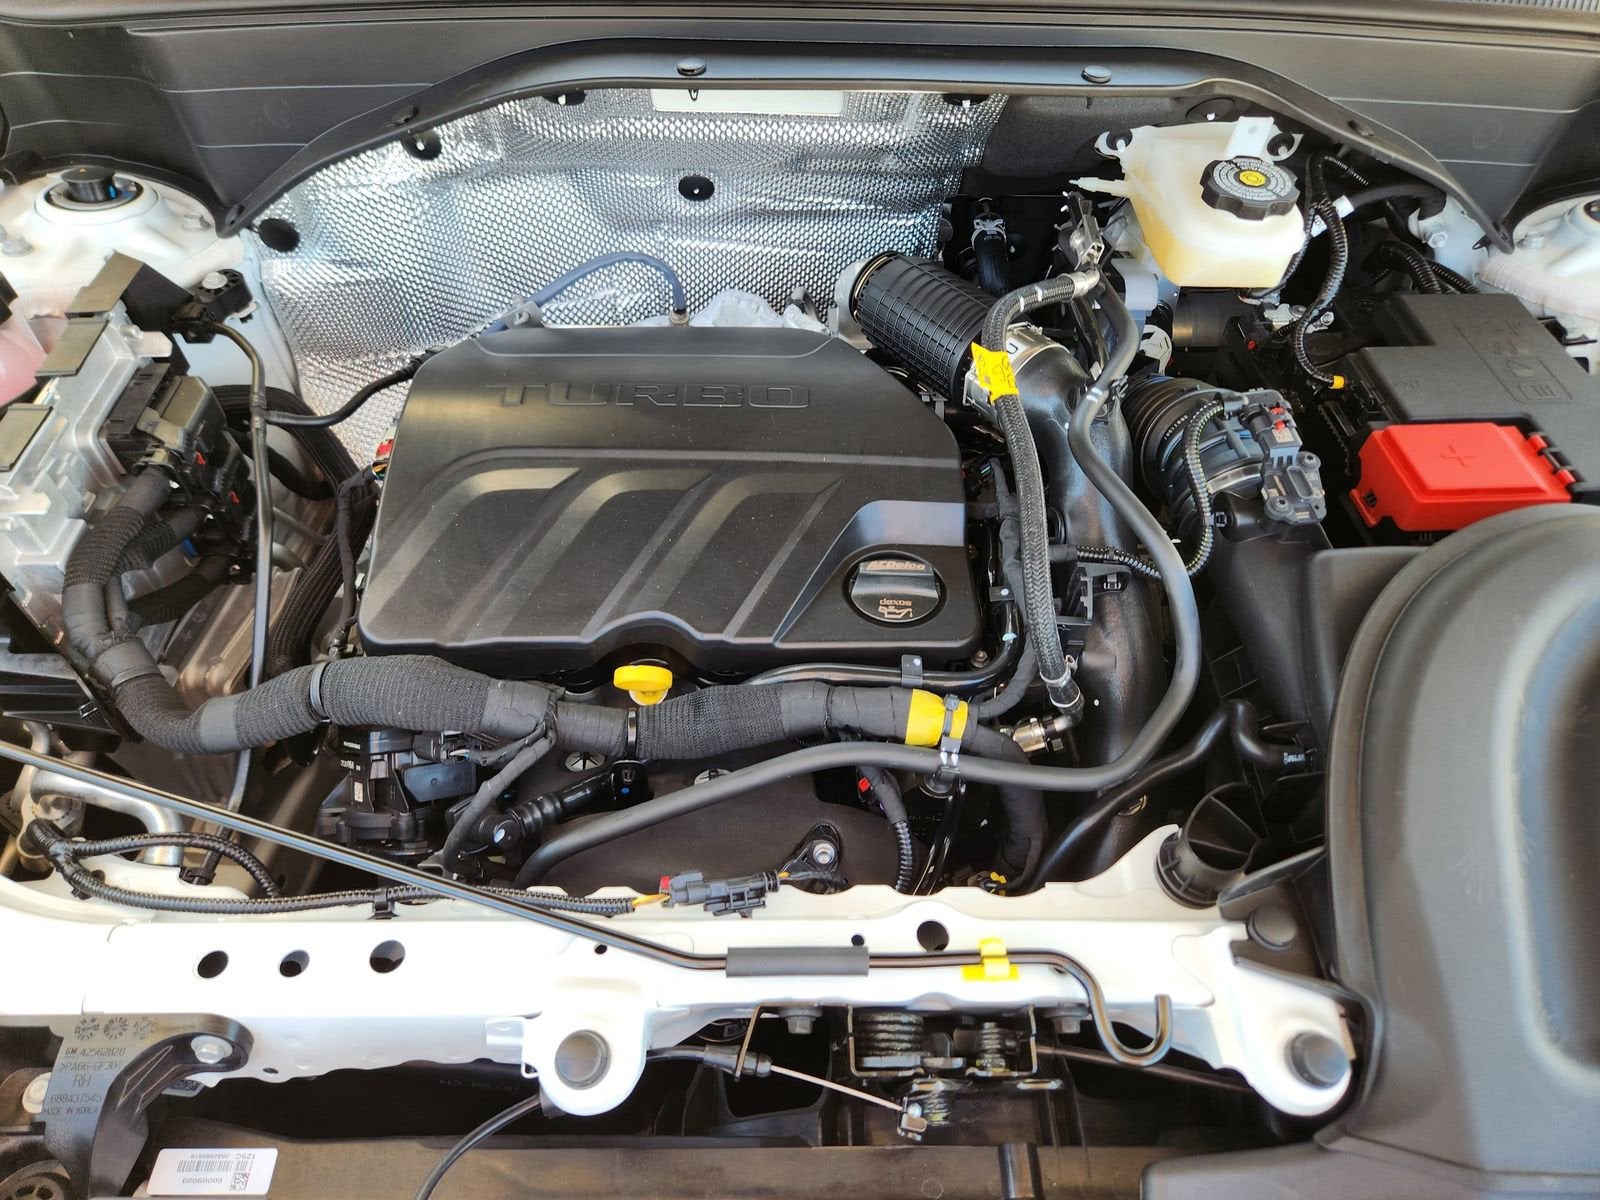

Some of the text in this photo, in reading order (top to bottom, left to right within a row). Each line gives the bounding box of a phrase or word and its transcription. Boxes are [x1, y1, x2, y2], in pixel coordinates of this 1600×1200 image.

[485, 383, 809, 408] TURBO
[866, 560, 926, 571] ACDelco
[879, 598, 913, 607] dexos
[64, 1047, 78, 1058] GM
[72, 1073, 92, 1088] RH
